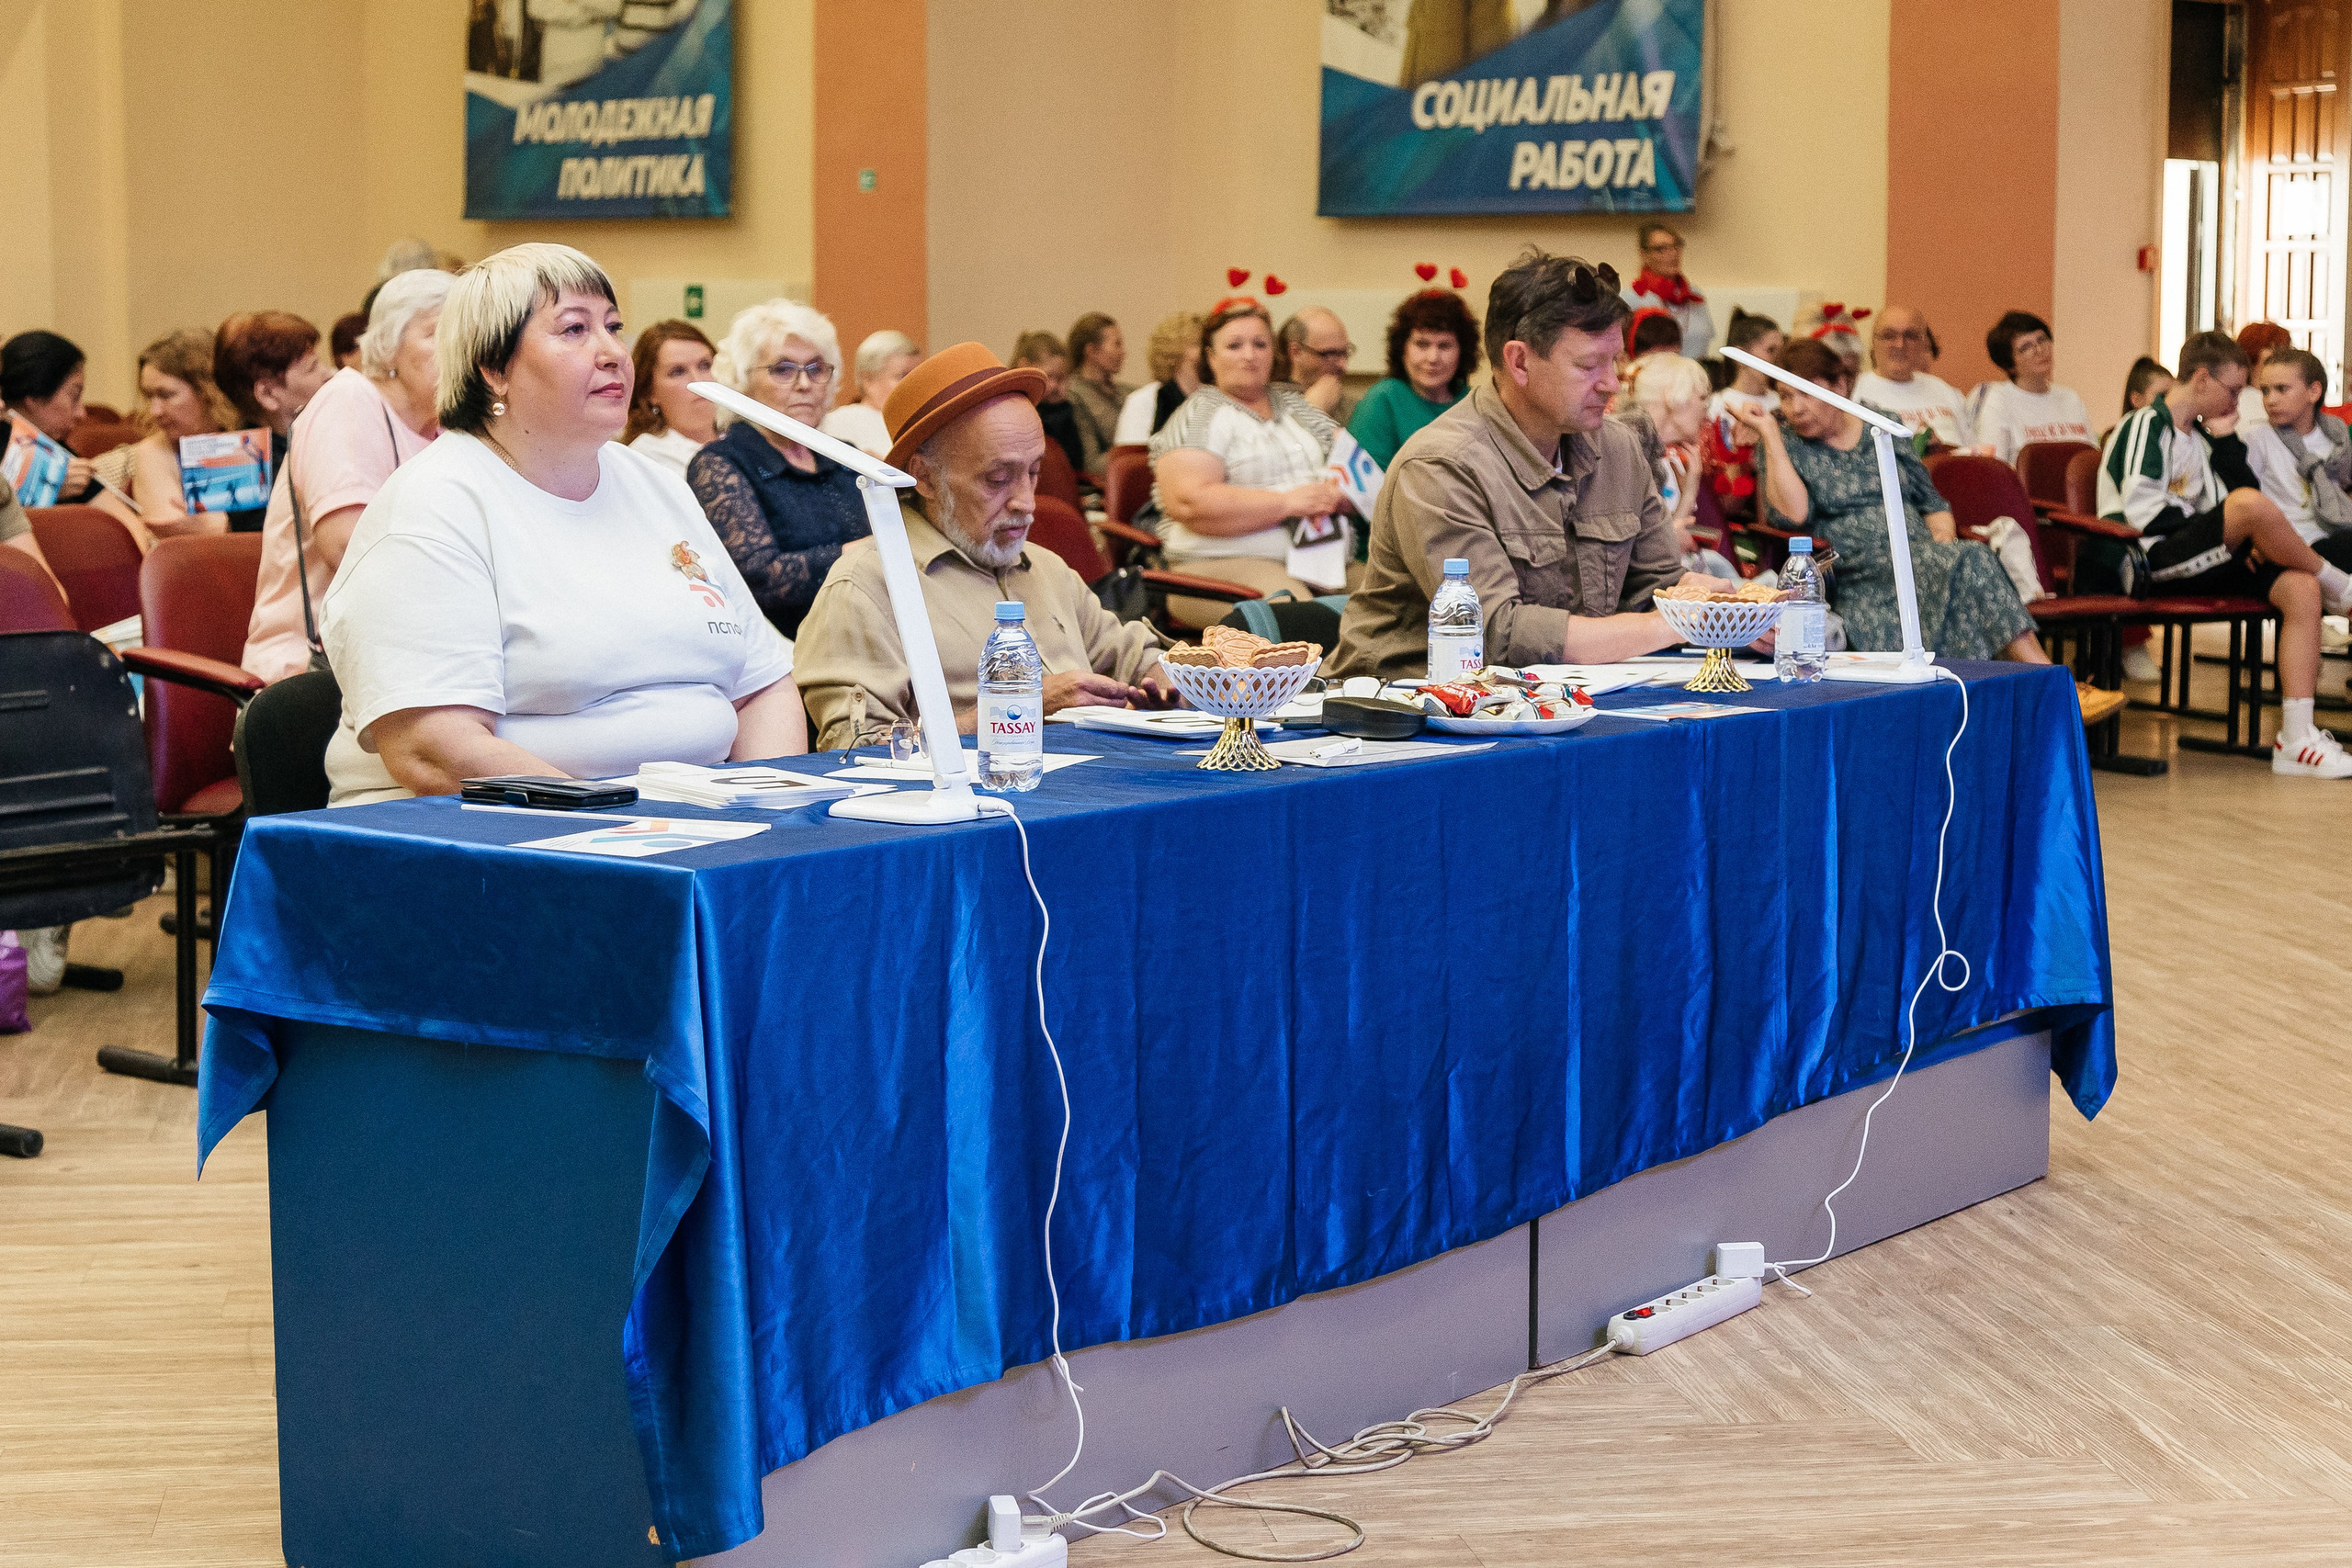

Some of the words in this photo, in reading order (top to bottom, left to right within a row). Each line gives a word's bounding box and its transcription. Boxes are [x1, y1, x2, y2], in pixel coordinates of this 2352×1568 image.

[513, 95, 715, 146] МОЛОДЕЖНАЯ
[1412, 71, 1674, 132] СОЦИАЛЬНАЯ
[558, 154, 705, 198] ПОЛИТИКА
[1510, 139, 1656, 189] РАБОТА
[990, 721, 1036, 734] TASSAY
